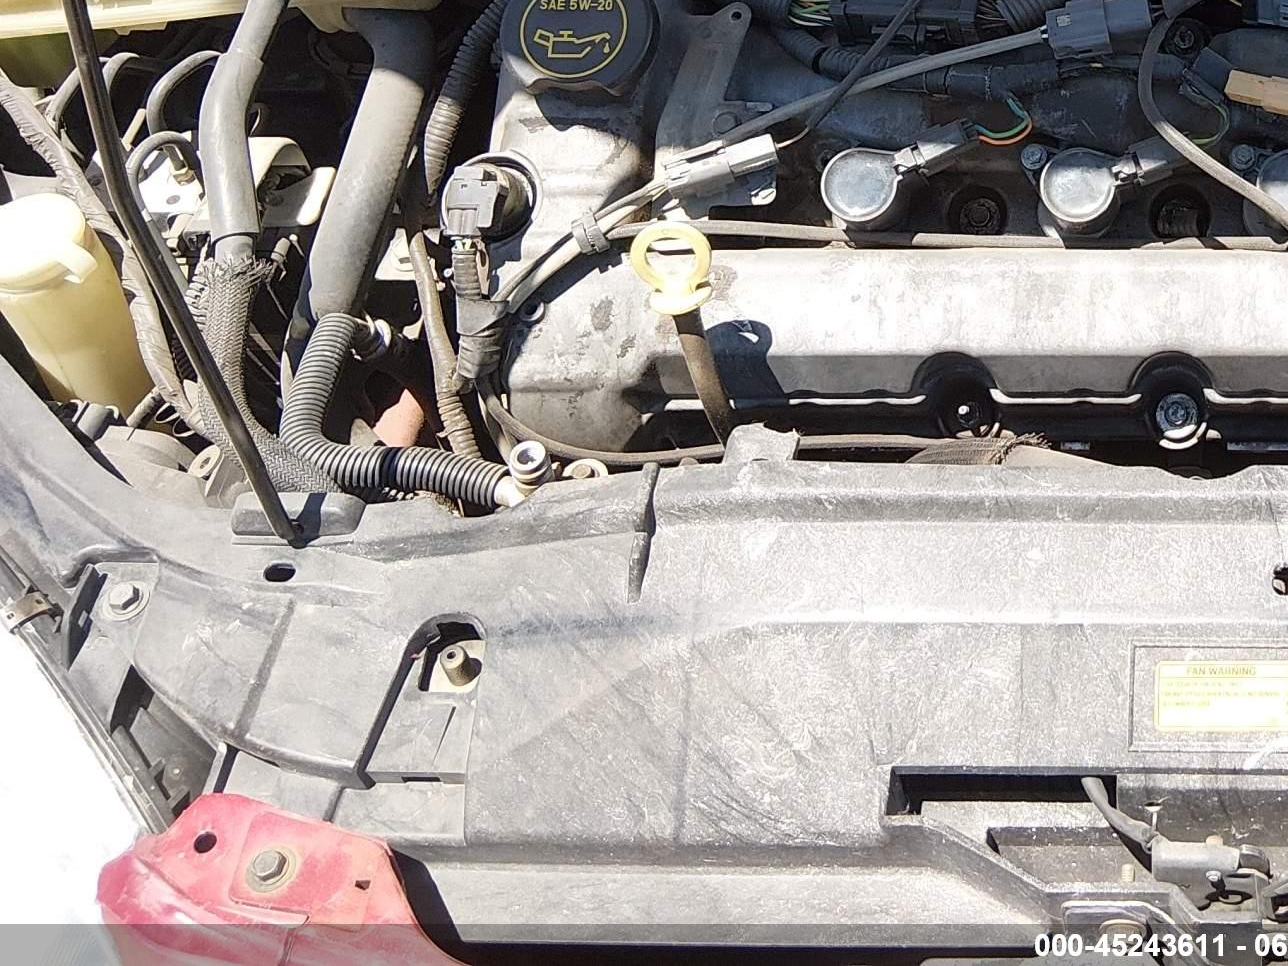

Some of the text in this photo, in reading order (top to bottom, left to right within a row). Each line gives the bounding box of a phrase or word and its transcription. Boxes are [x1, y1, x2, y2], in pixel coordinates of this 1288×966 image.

[540, 0, 613, 10] SAE 5W-20
[1186, 667, 1257, 676] FAN WARNING
